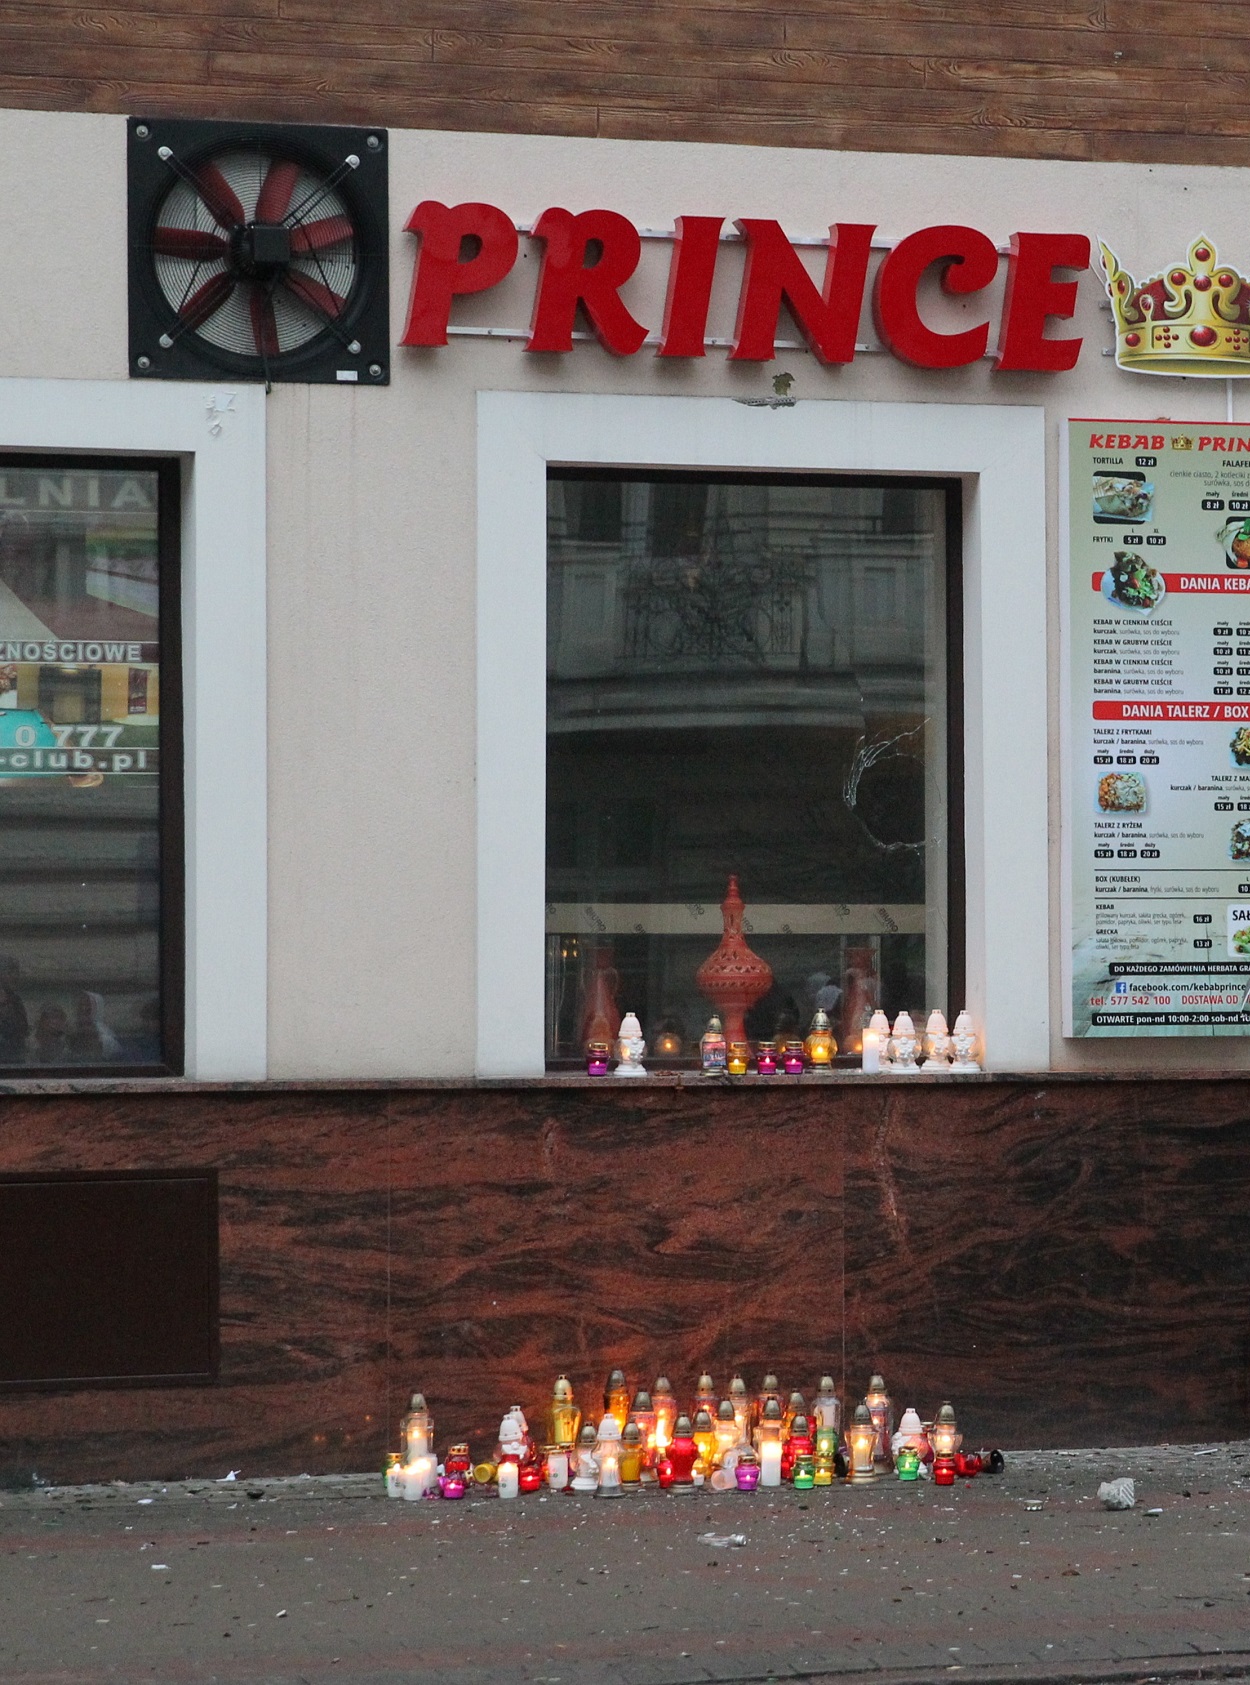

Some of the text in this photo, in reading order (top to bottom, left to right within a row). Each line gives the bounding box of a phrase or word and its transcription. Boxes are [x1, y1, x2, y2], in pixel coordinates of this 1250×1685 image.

[403, 200, 1090, 373] PRINCE
[1090, 434, 1164, 450] KEBAB
[1181, 578, 1220, 590] DANIA
[1123, 705, 1248, 718] DANIA TALERZ / BOX
[15, 726, 123, 747] 0 777
[1091, 996, 1106, 1005] tel.
[1111, 996, 1128, 1005] 577
[1132, 996, 1149, 1005] 542
[1154, 996, 1170, 1005] 100
[1182, 996, 1223, 1005] DOSTAWA
[1226, 996, 1238, 1004] OD
[1137, 1015, 1165, 1024] pon-nd
